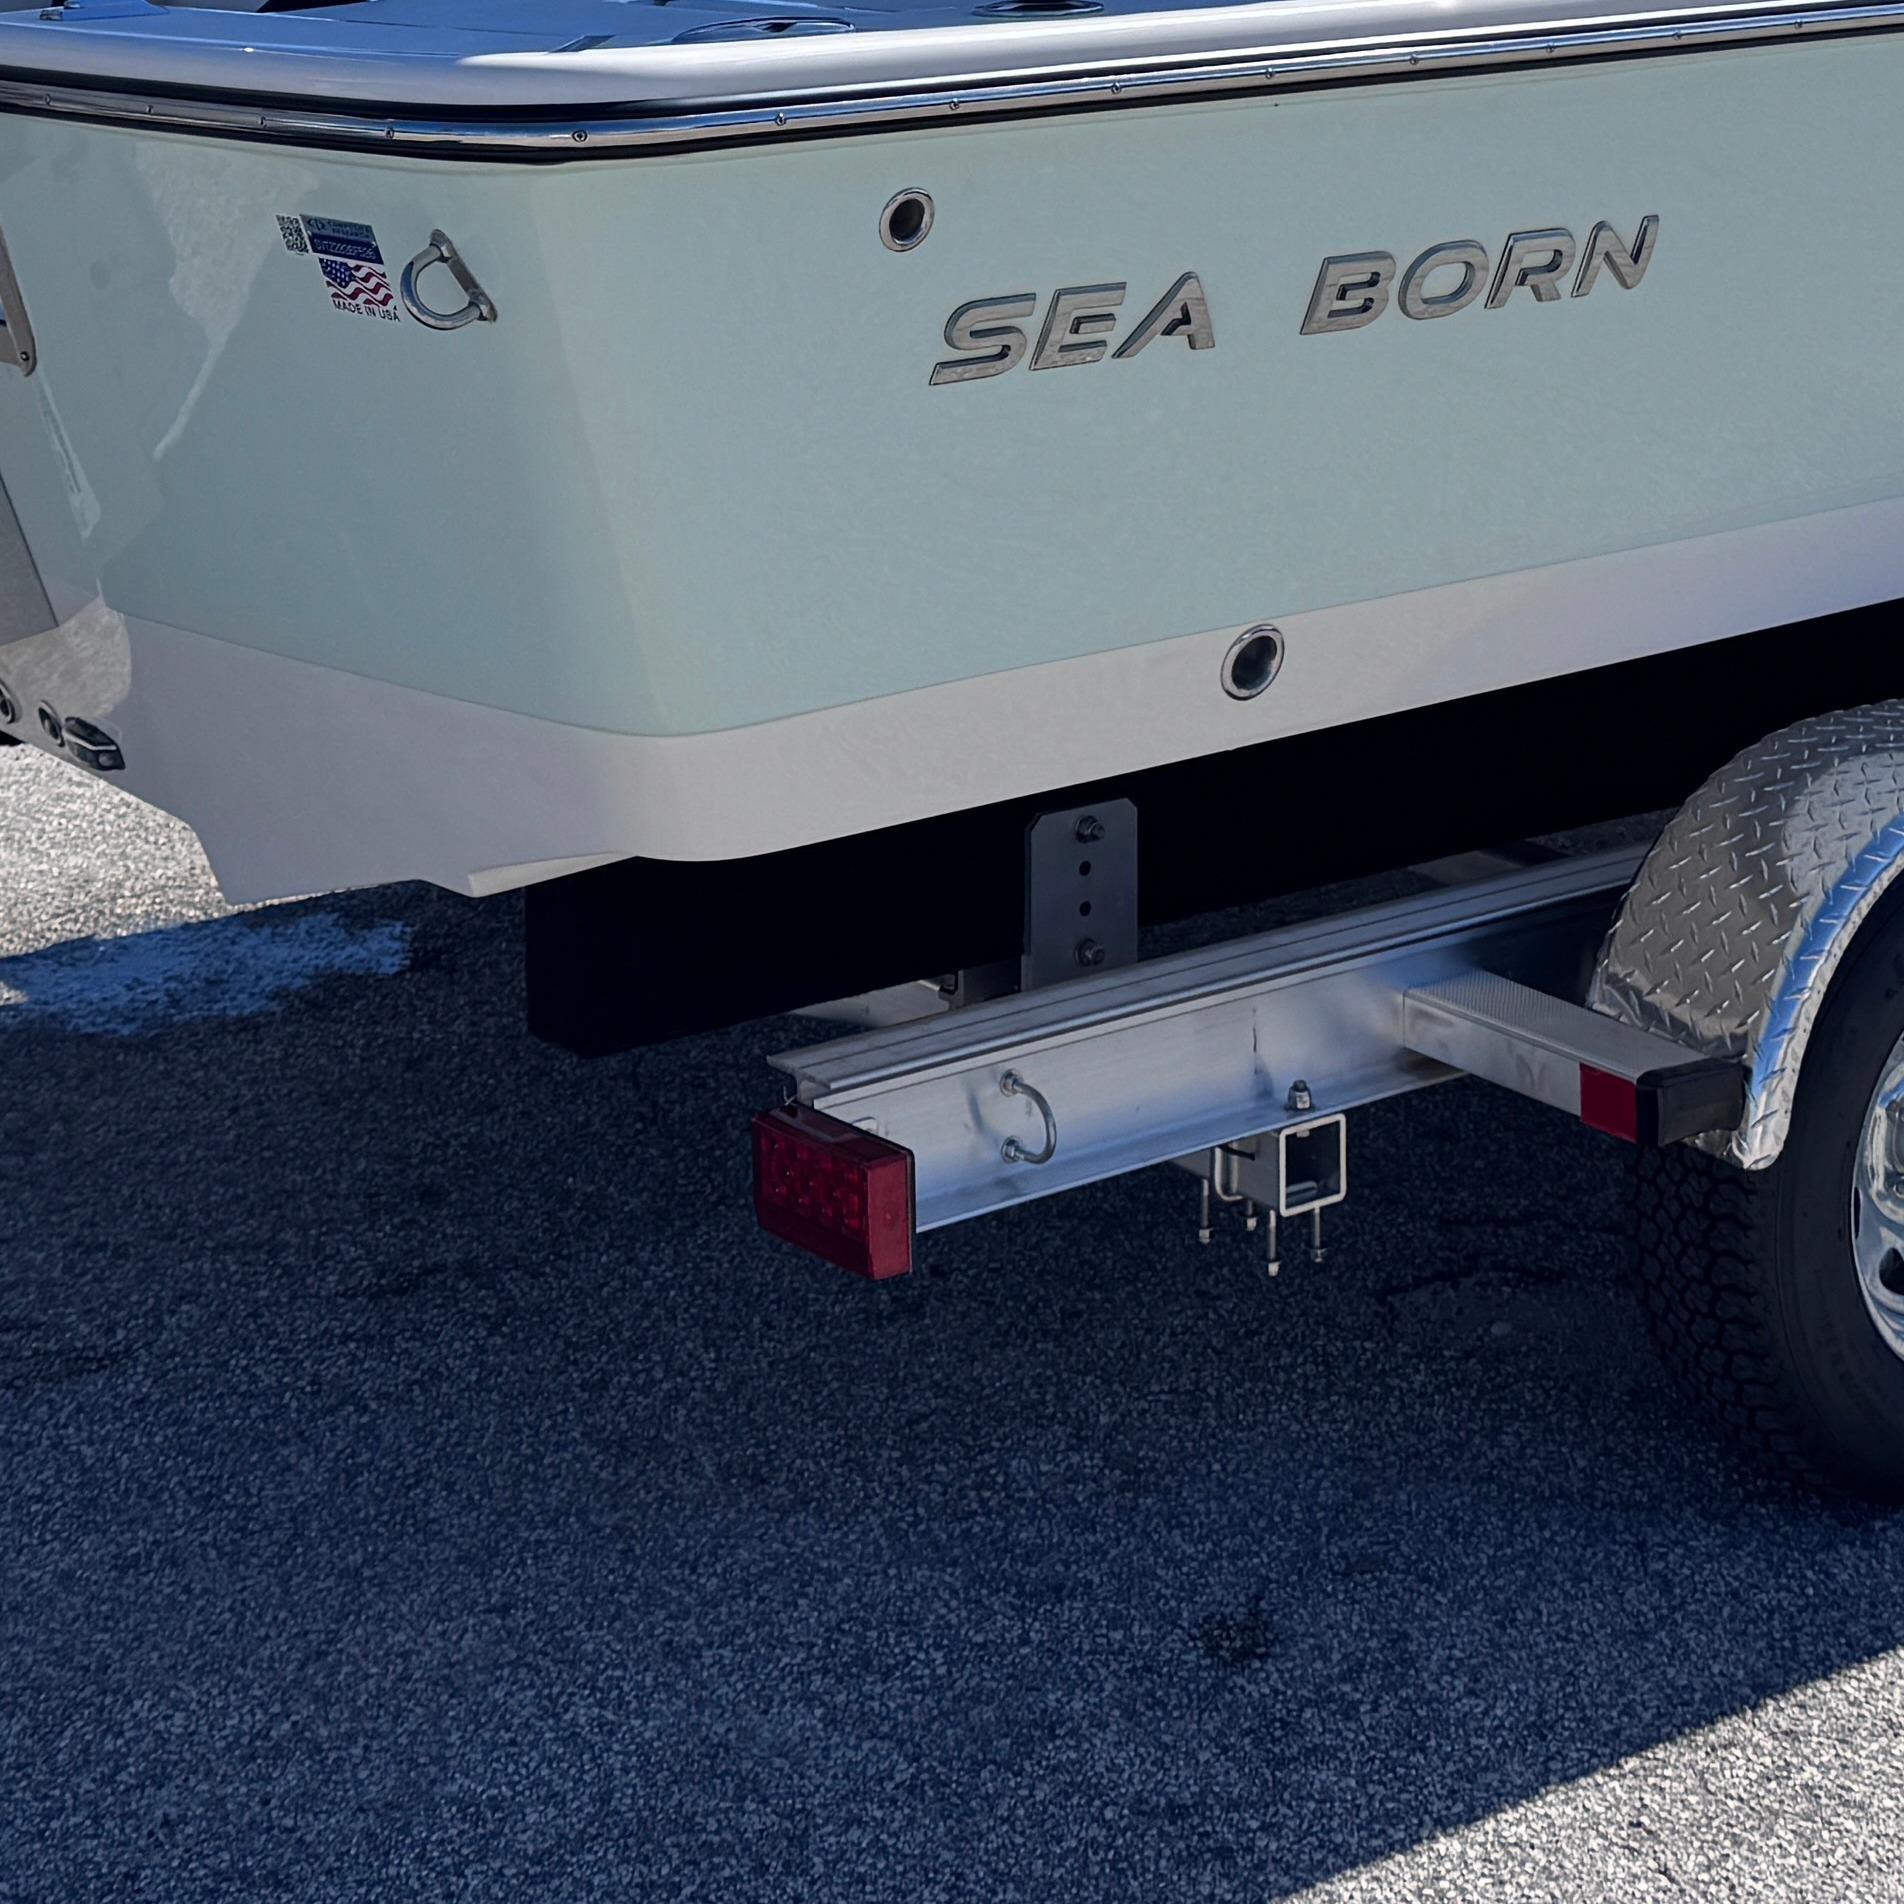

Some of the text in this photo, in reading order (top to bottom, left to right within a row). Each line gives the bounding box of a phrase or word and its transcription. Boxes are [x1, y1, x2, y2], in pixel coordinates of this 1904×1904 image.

[332, 298, 401, 322] MADE IN USA
[927, 212, 1663, 388] SEA BORN
